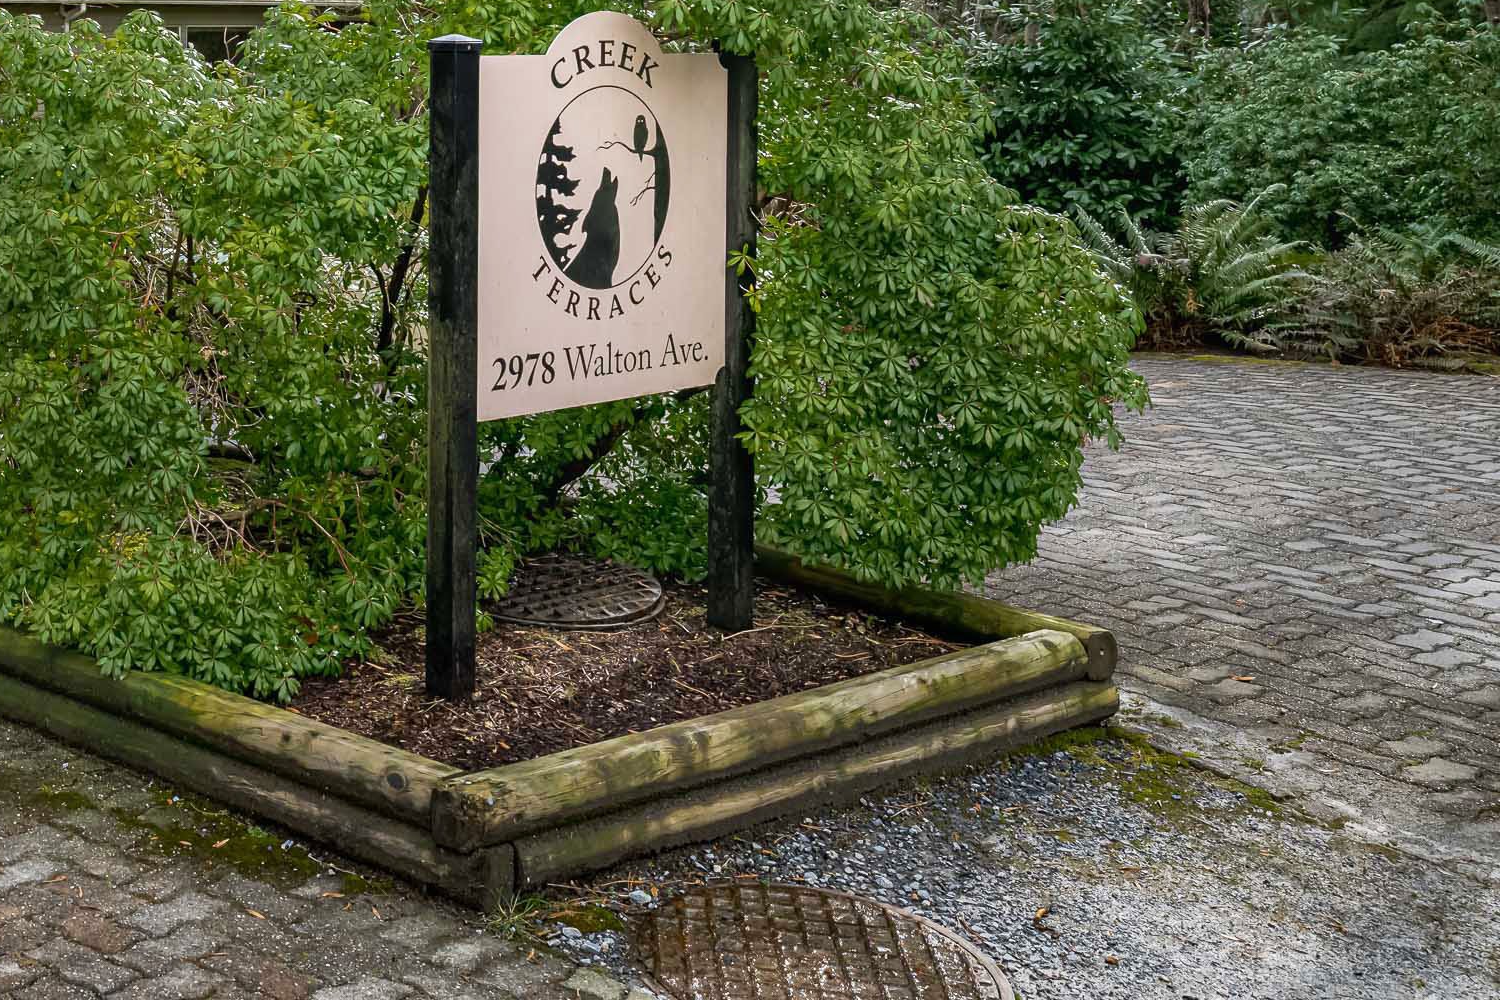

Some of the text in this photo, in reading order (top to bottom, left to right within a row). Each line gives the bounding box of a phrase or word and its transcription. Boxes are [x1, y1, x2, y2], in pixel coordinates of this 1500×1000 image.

[550, 40, 660, 89] CREEK
[532, 244, 673, 320] TERRACES
[491, 333, 709, 392] 2978 Walton Ave.
